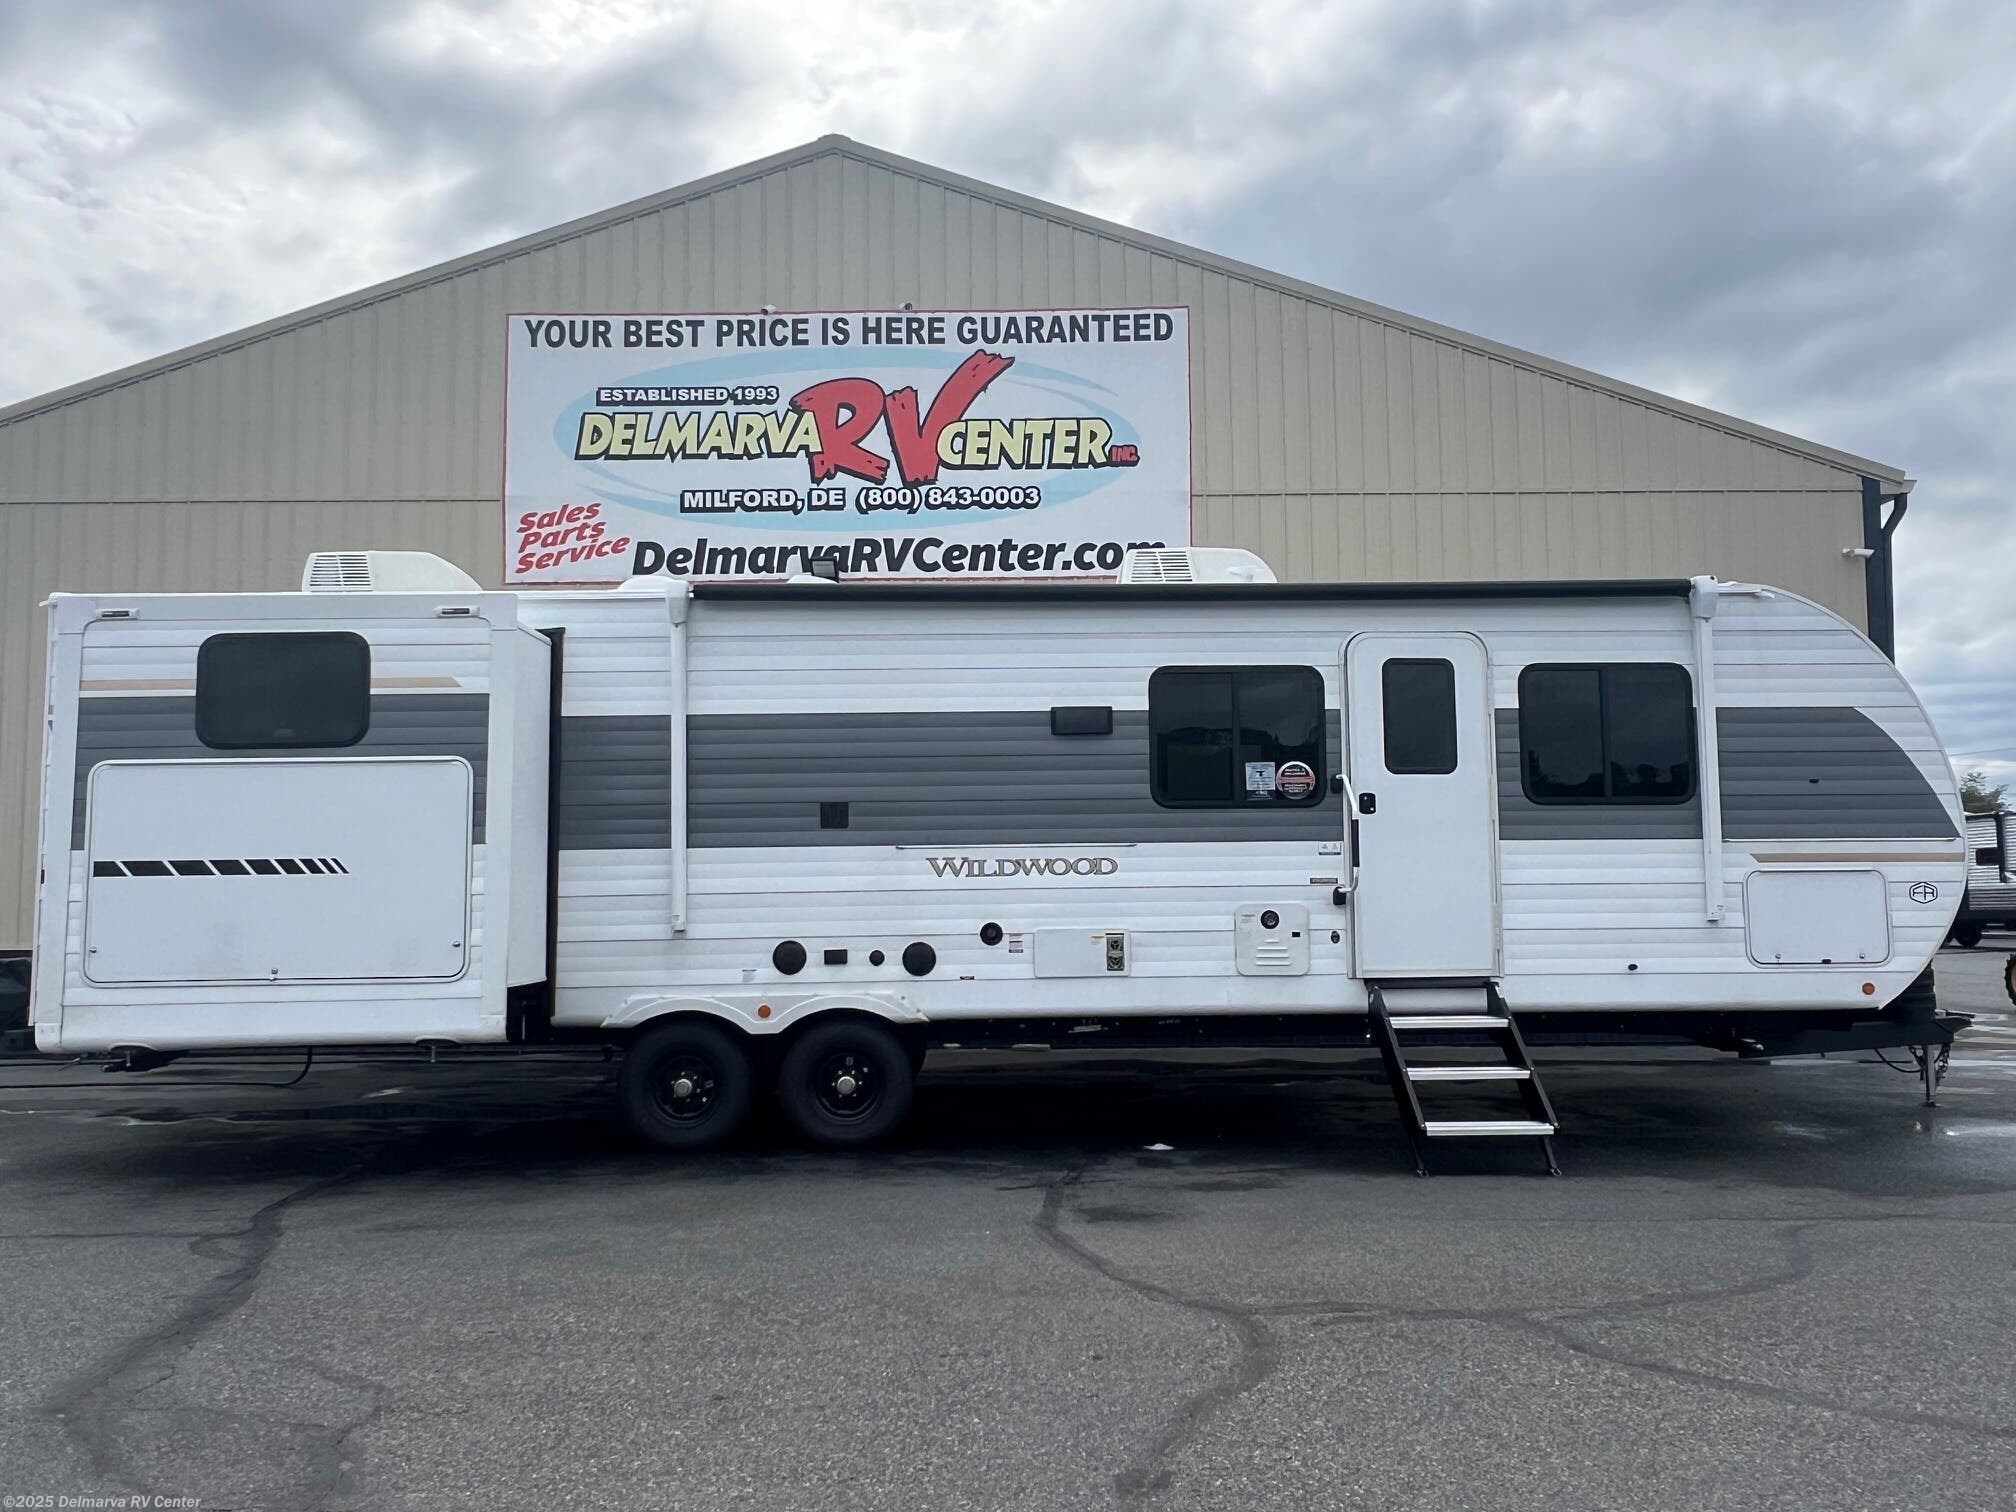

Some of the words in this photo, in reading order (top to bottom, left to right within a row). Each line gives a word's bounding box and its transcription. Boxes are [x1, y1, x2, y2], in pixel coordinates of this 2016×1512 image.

[524, 319, 612, 348] YOUR
[623, 319, 705, 347] BEST
[716, 318, 810, 347] PRICE
[821, 317, 850, 346] IS
[861, 316, 945, 345] HERE
[956, 314, 1173, 344] GUARANTEED
[598, 387, 729, 403] ESTABLISHED
[732, 387, 779, 402] 1993
[576, 411, 823, 458] DELMARVA
[789, 349, 1015, 486] RV
[937, 418, 1112, 467] CENTER
[683, 490, 803, 511] MILFORD,
[811, 490, 844, 507] DE
[859, 488, 921, 511] (800)
[928, 487, 1040, 506] 843-0003
[516, 503, 602, 533] Sales
[518, 521, 607, 553] Parts
[515, 537, 630, 574] Service
[632, 538, 1166, 575] DelmarvaRVCenter.co
[925, 857, 1118, 877] WILDWOOD
